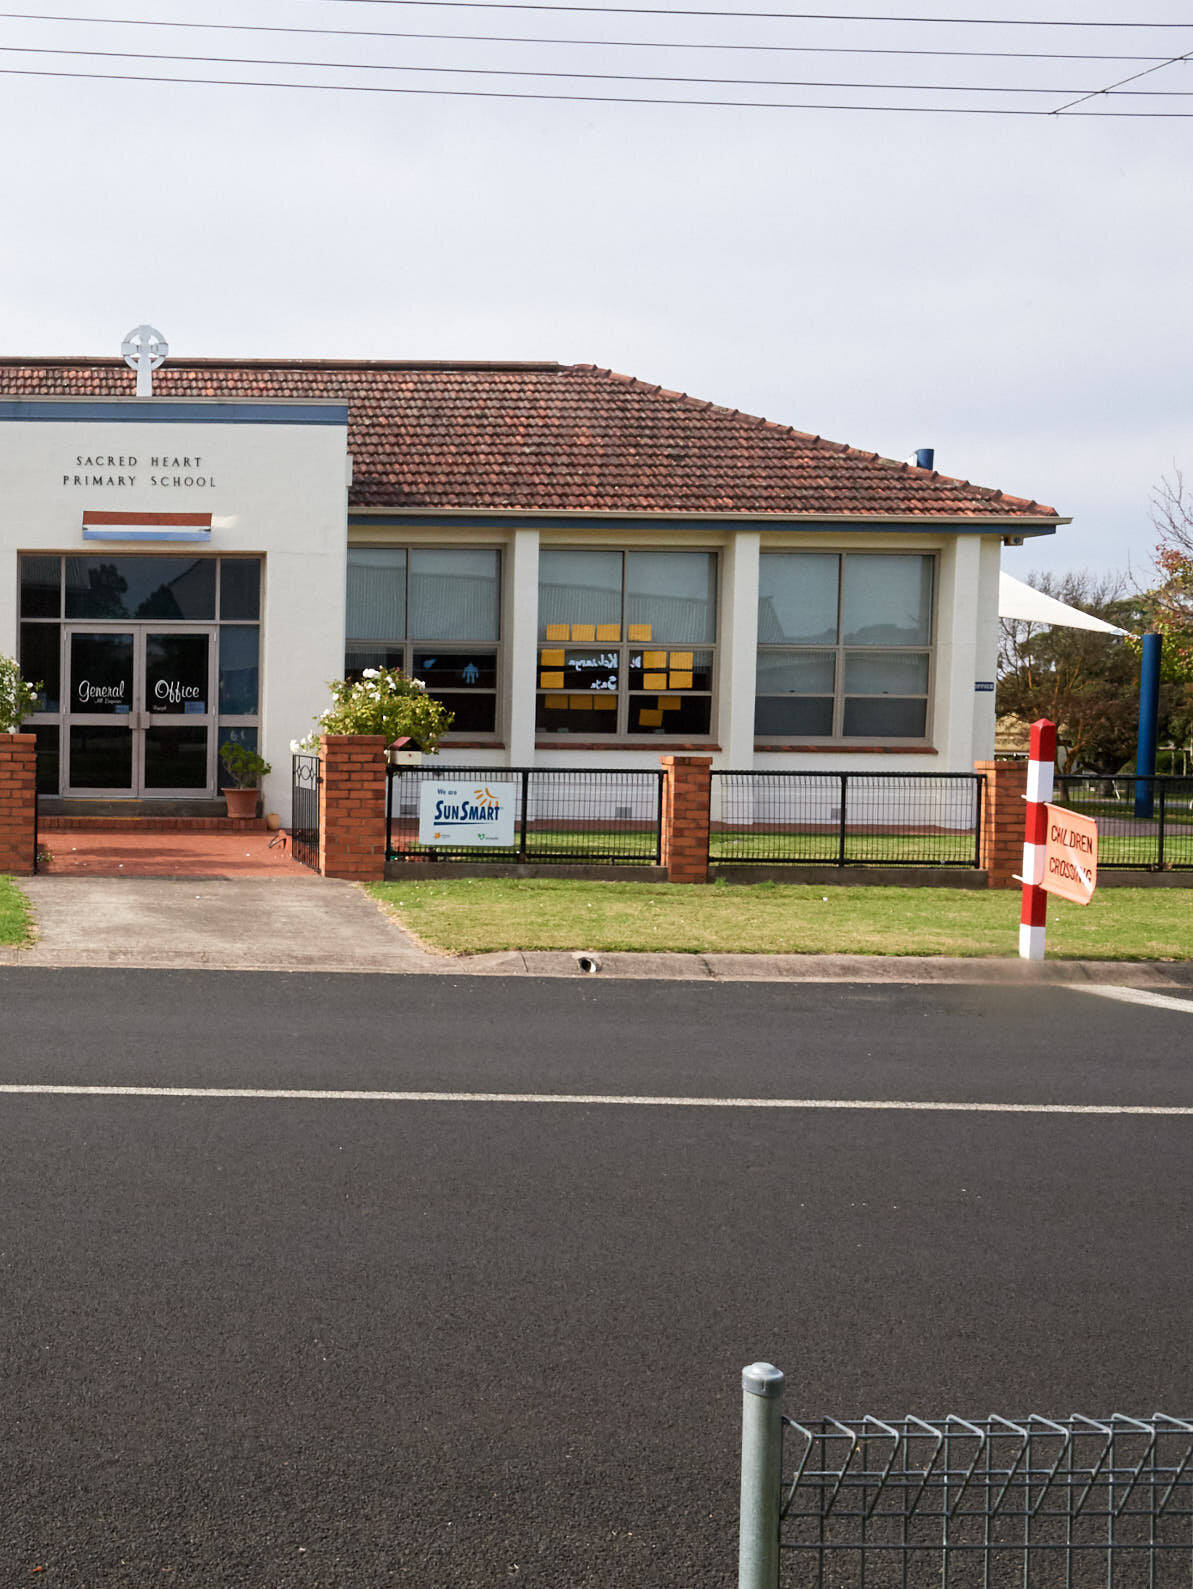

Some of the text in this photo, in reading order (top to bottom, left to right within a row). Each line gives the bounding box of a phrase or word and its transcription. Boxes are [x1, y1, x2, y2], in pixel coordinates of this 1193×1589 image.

[76, 456, 202, 468] SACRED HEART
[63, 475, 216, 488] PRIMARY SCHOOL
[78, 680, 200, 703] General Office
[1051, 825, 1092, 854] CHILDREN
